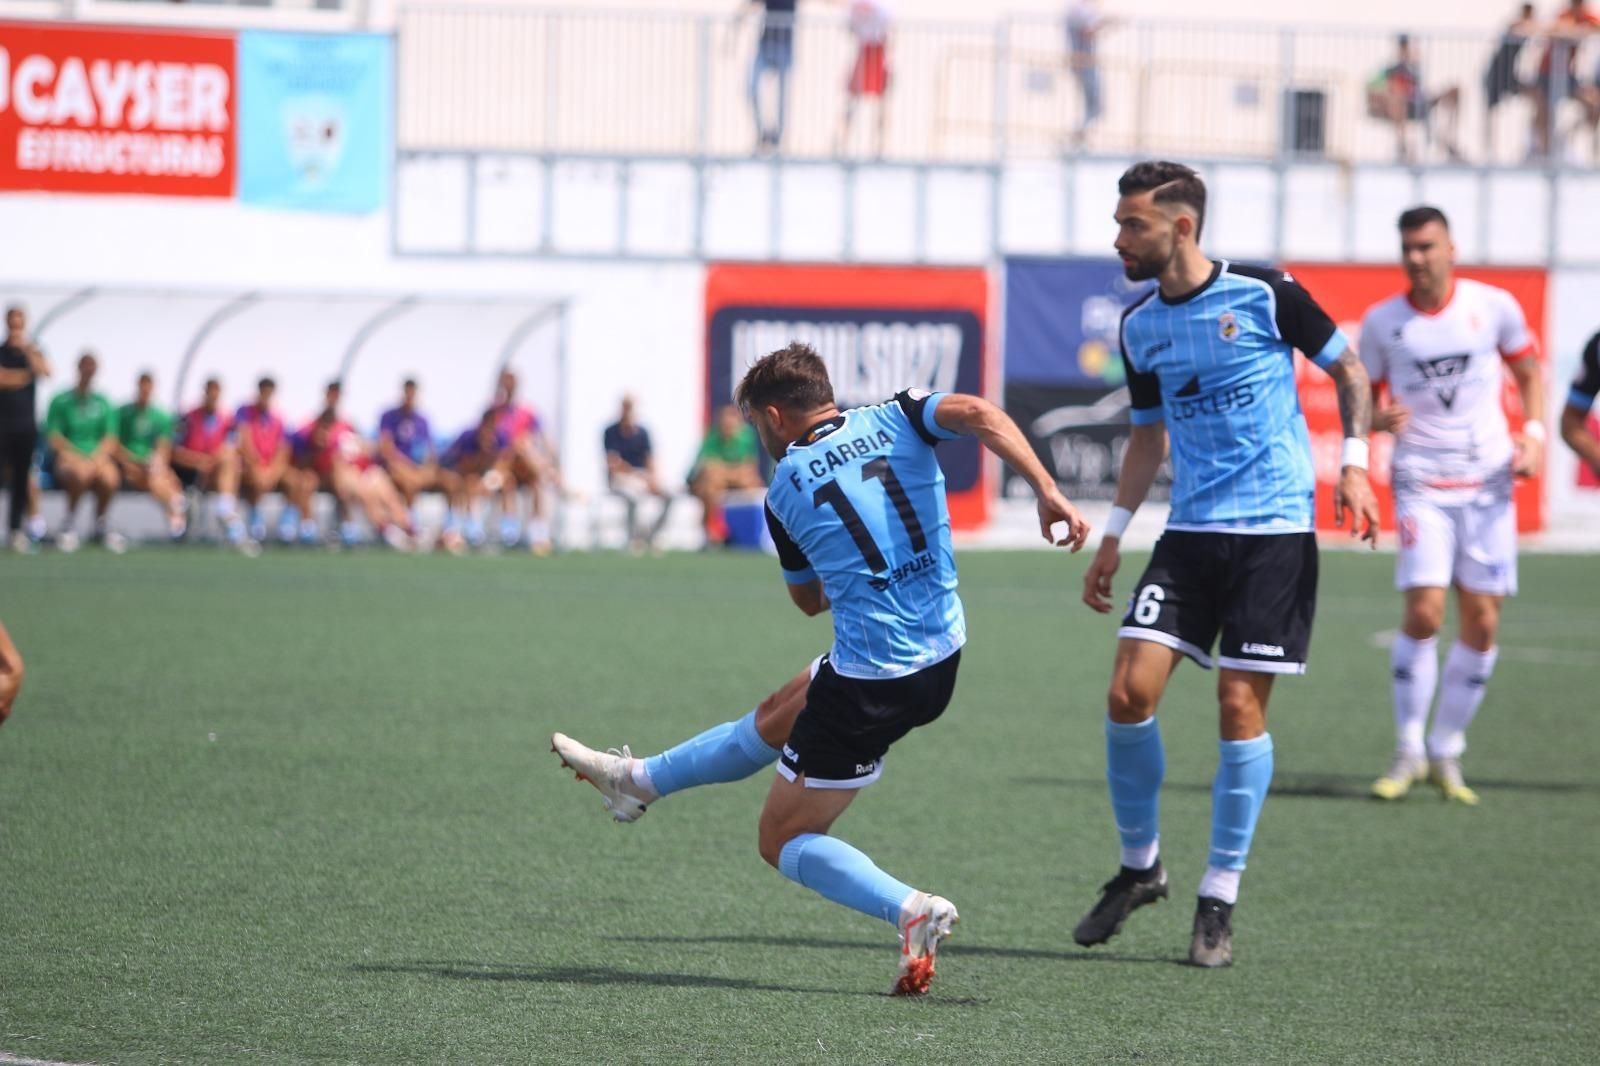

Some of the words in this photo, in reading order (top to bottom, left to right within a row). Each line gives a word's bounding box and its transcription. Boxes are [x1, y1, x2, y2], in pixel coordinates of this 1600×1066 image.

[13, 54, 230, 134] CAYSER
[16, 126, 225, 178] ESTRUCTURAS
[789, 429, 895, 493] F.CARBIA
[813, 455, 928, 576] 11
[1133, 583, 1165, 626] 6
